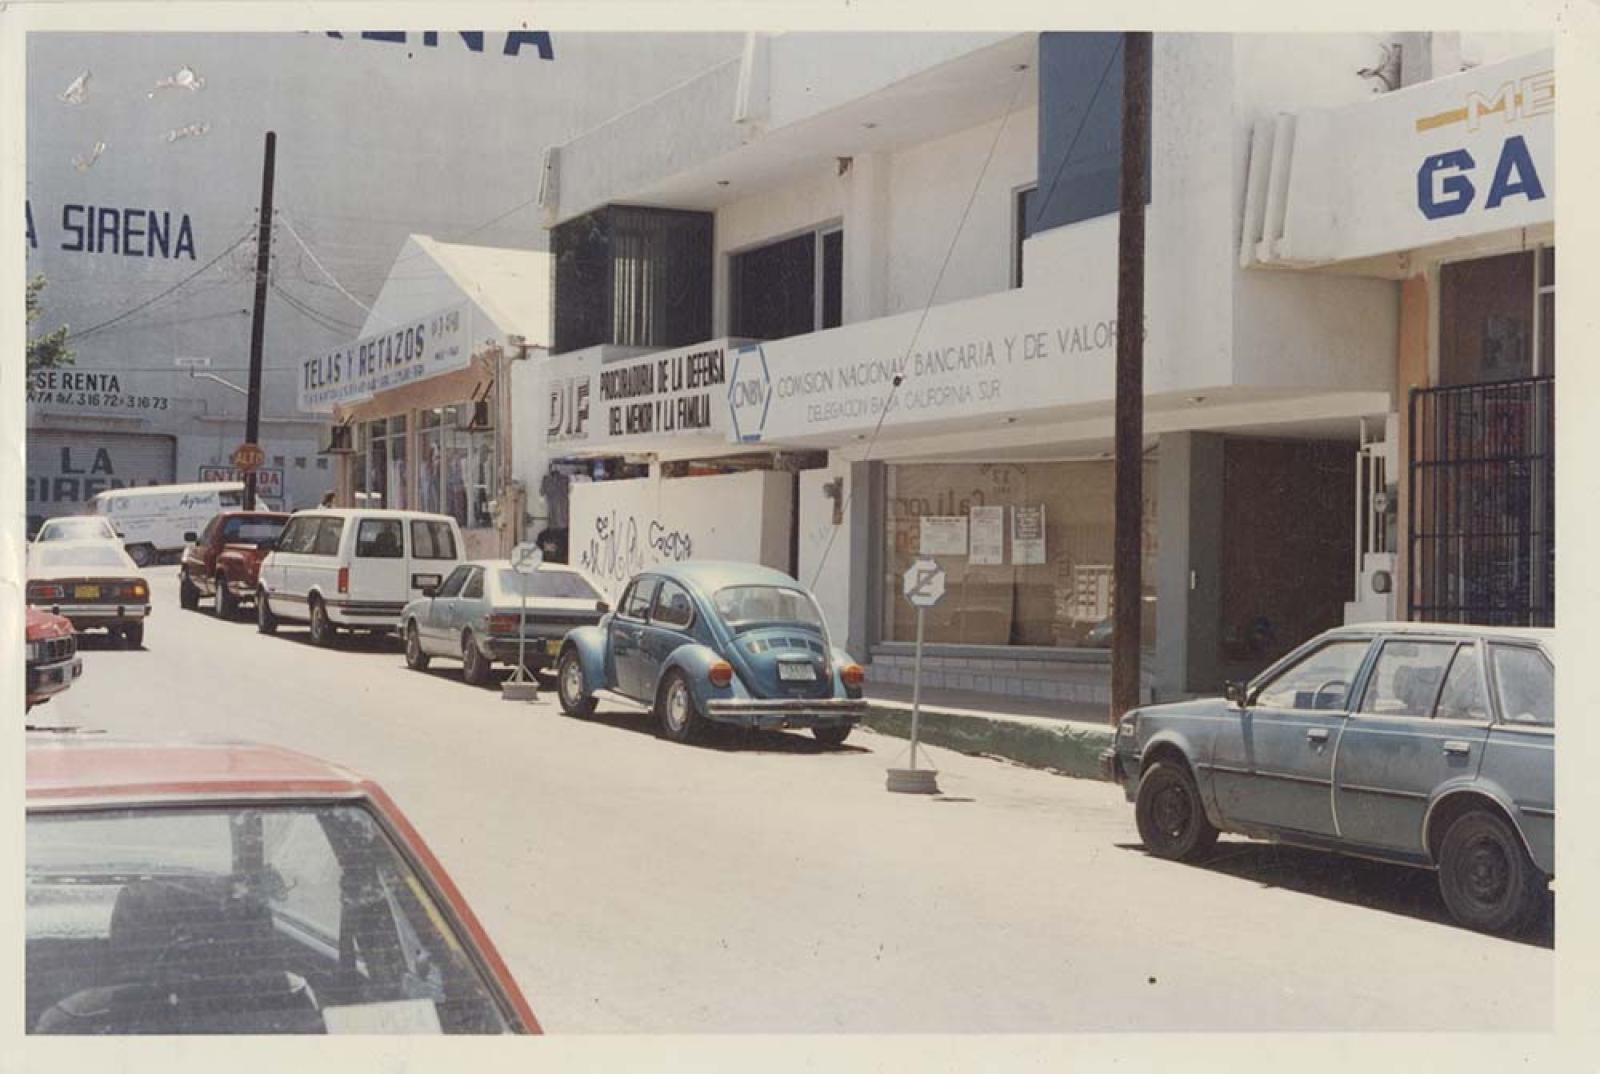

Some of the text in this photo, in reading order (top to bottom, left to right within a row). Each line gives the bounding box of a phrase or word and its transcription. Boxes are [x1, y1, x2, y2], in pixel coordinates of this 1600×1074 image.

[1416, 135, 1547, 221] GA
[61, 203, 196, 261] SIRENA
[303, 353, 342, 391] TELAS
[358, 323, 426, 377] RETAZOS
[913, 341, 996, 377] BANCARIA
[1004, 335, 1018, 364] Y
[1023, 332, 1049, 361] DE
[1056, 313, 1149, 354] VALOR
[37, 371, 121, 393] SE RENTA
[657, 358, 669, 394] DE
[671, 356, 683, 392] LA
[687, 348, 725, 389] DEFENSA
[905, 382, 971, 410] CALIFORNIA
[978, 378, 1000, 401] SUR
[546, 376, 591, 437] DIF
[609, 405, 623, 437] DEL
[626, 402, 653, 434] MENOR
[663, 399, 675, 432] LA
[677, 392, 711, 430] FAMILIA
[61, 446, 115, 475] LA
[204, 469, 280, 485] ENTRDA
